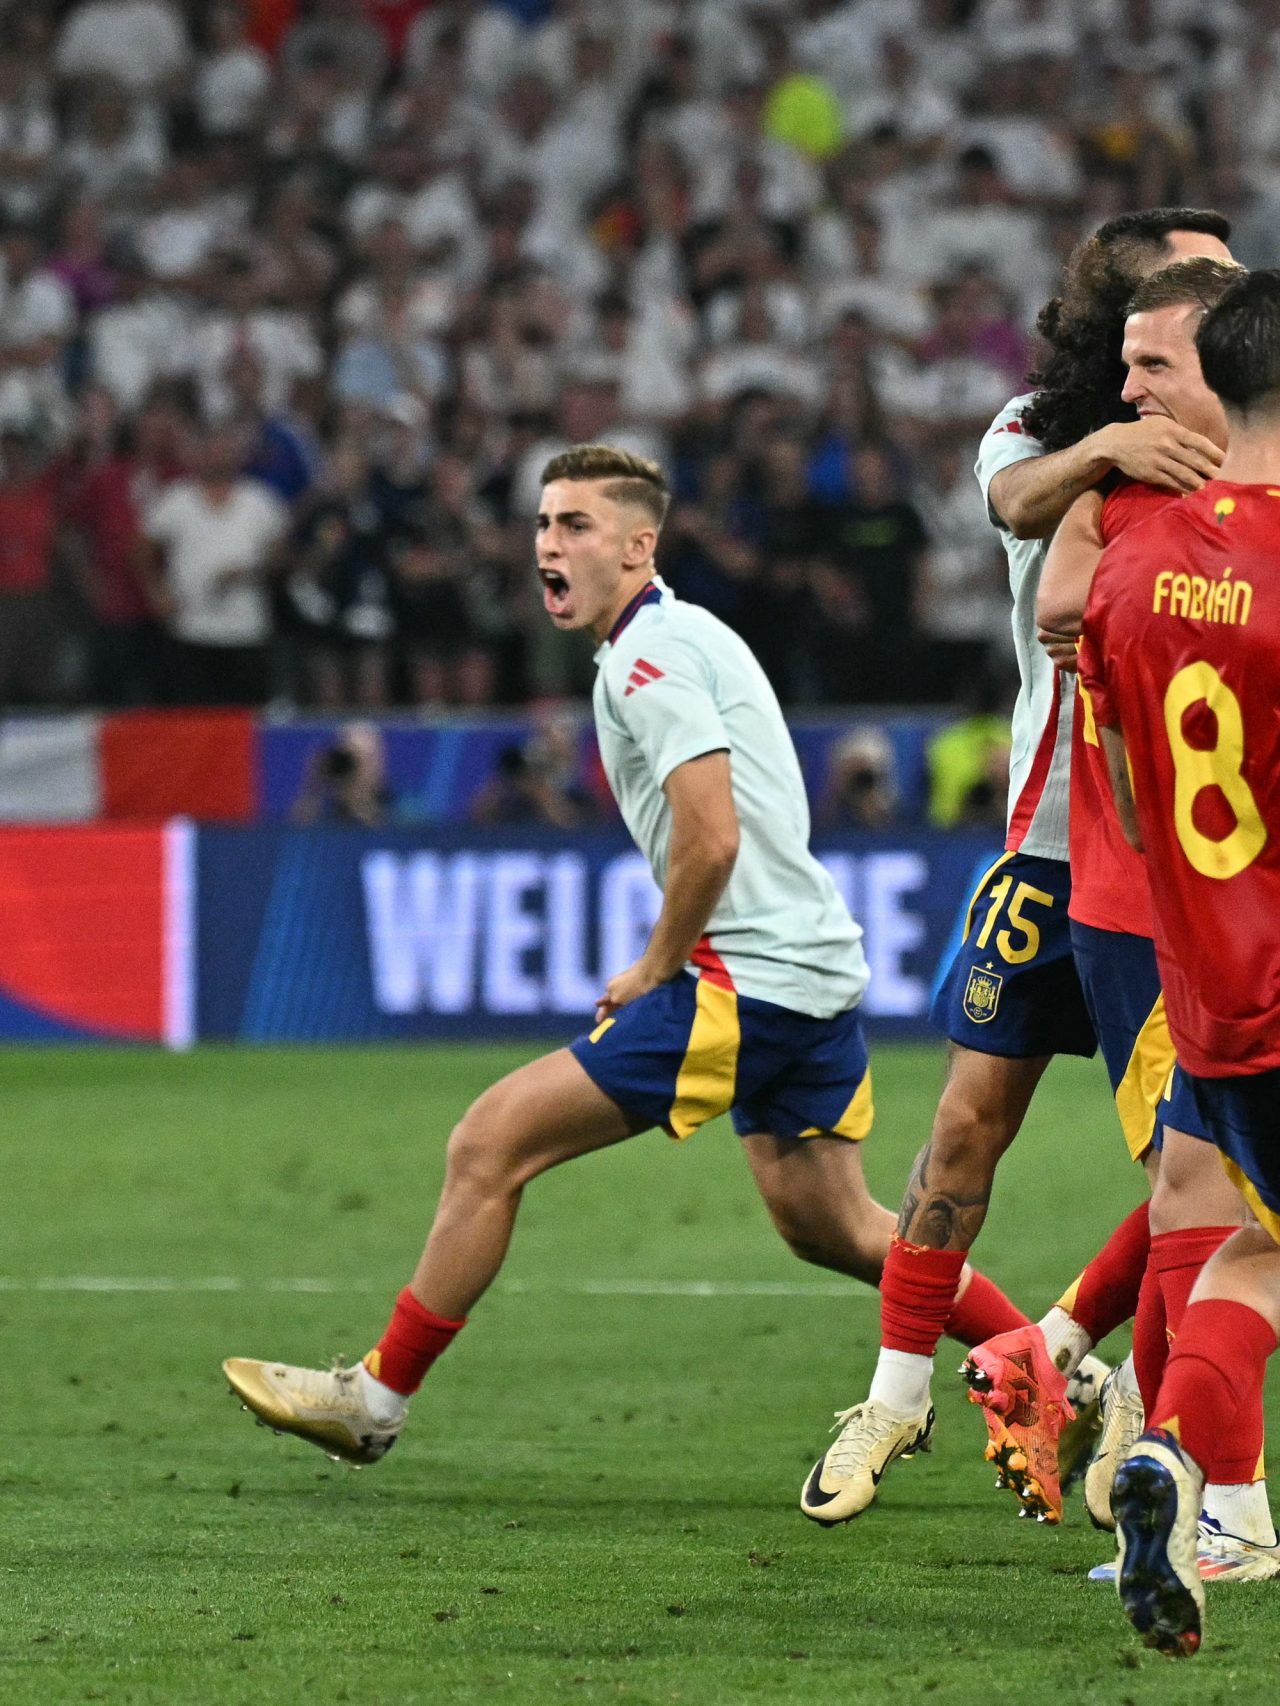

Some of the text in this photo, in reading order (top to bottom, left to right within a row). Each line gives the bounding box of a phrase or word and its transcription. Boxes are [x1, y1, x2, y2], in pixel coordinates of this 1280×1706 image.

[1152, 566, 1253, 626] FABIÁN
[1164, 660, 1267, 880] 8
[360, 850, 929, 1017] WELCE
[976, 874, 1054, 964] 15
